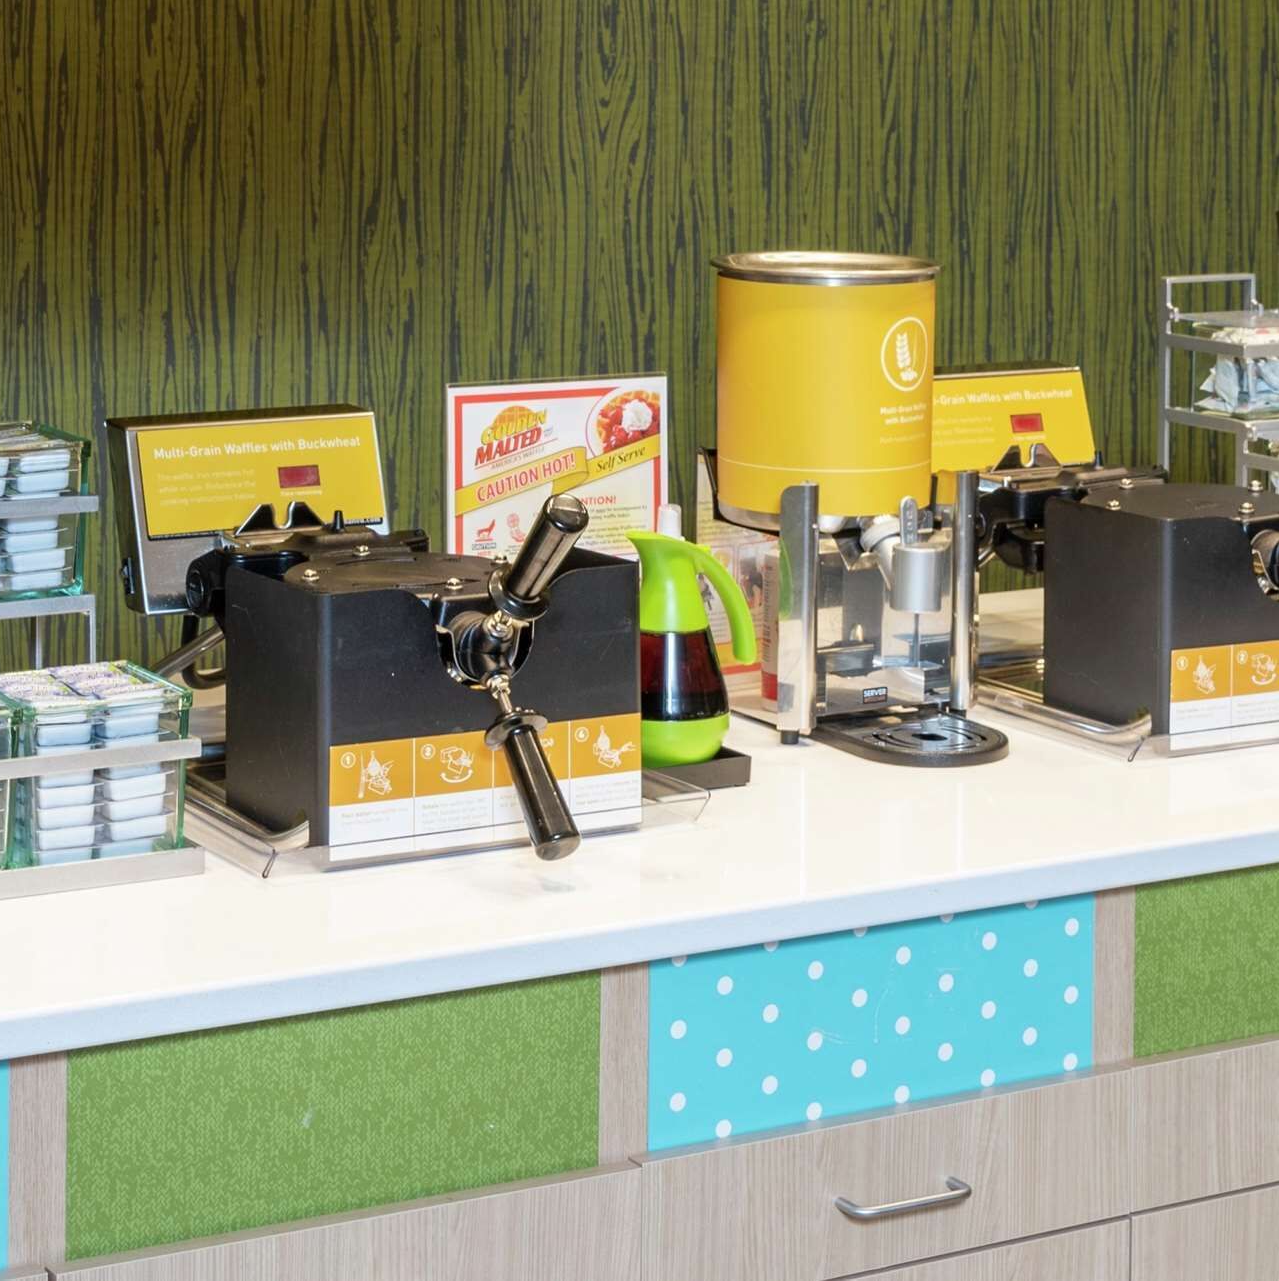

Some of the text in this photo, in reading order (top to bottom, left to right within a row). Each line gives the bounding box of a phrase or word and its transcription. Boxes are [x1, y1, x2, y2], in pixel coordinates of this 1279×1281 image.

[1003, 390, 1022, 401] with
[153, 436, 361, 460] Multi-Grain Waffles with Buckwheat
[475, 427, 543, 466] MALTED
[595, 446, 646, 474] Self Serve
[477, 452, 576, 502] CAUTION HOT!
[581, 495, 617, 506] NTION!
